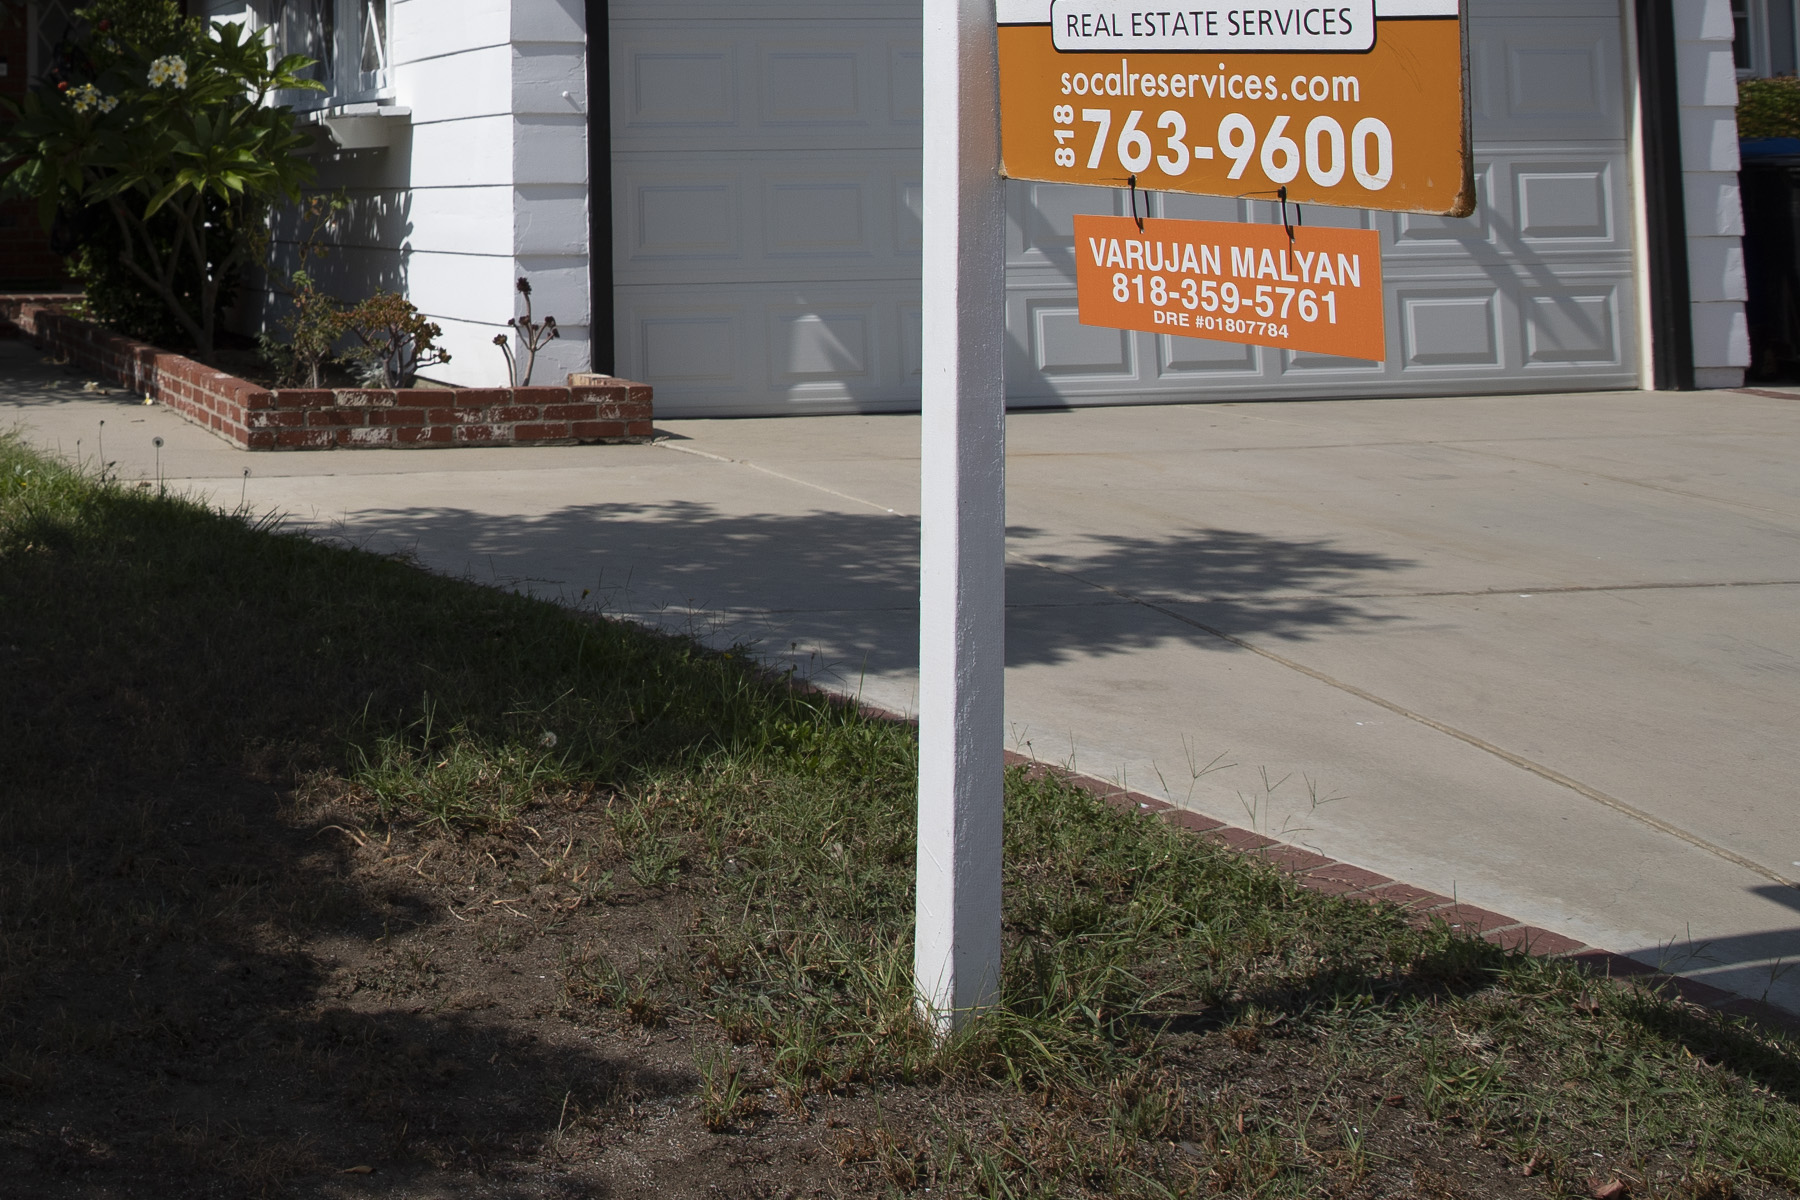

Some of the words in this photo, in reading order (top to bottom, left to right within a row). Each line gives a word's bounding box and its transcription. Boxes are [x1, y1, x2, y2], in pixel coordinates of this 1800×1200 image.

[1067, 13, 1124, 37] REAL
[1131, 11, 1218, 37] ESTATE
[1227, 7, 1353, 36] SERVICES
[1061, 58, 1360, 102] socalreservices.com
[1053, 104, 1076, 168] 818
[1081, 108, 1393, 191] 763-9600
[1088, 237, 1222, 276] VARUJAN
[1230, 246, 1361, 288] MALYAN
[1112, 272, 1337, 325] 818-359-5761
[1153, 310, 1190, 327] DRE
[1195, 315, 1289, 339] #01807784
